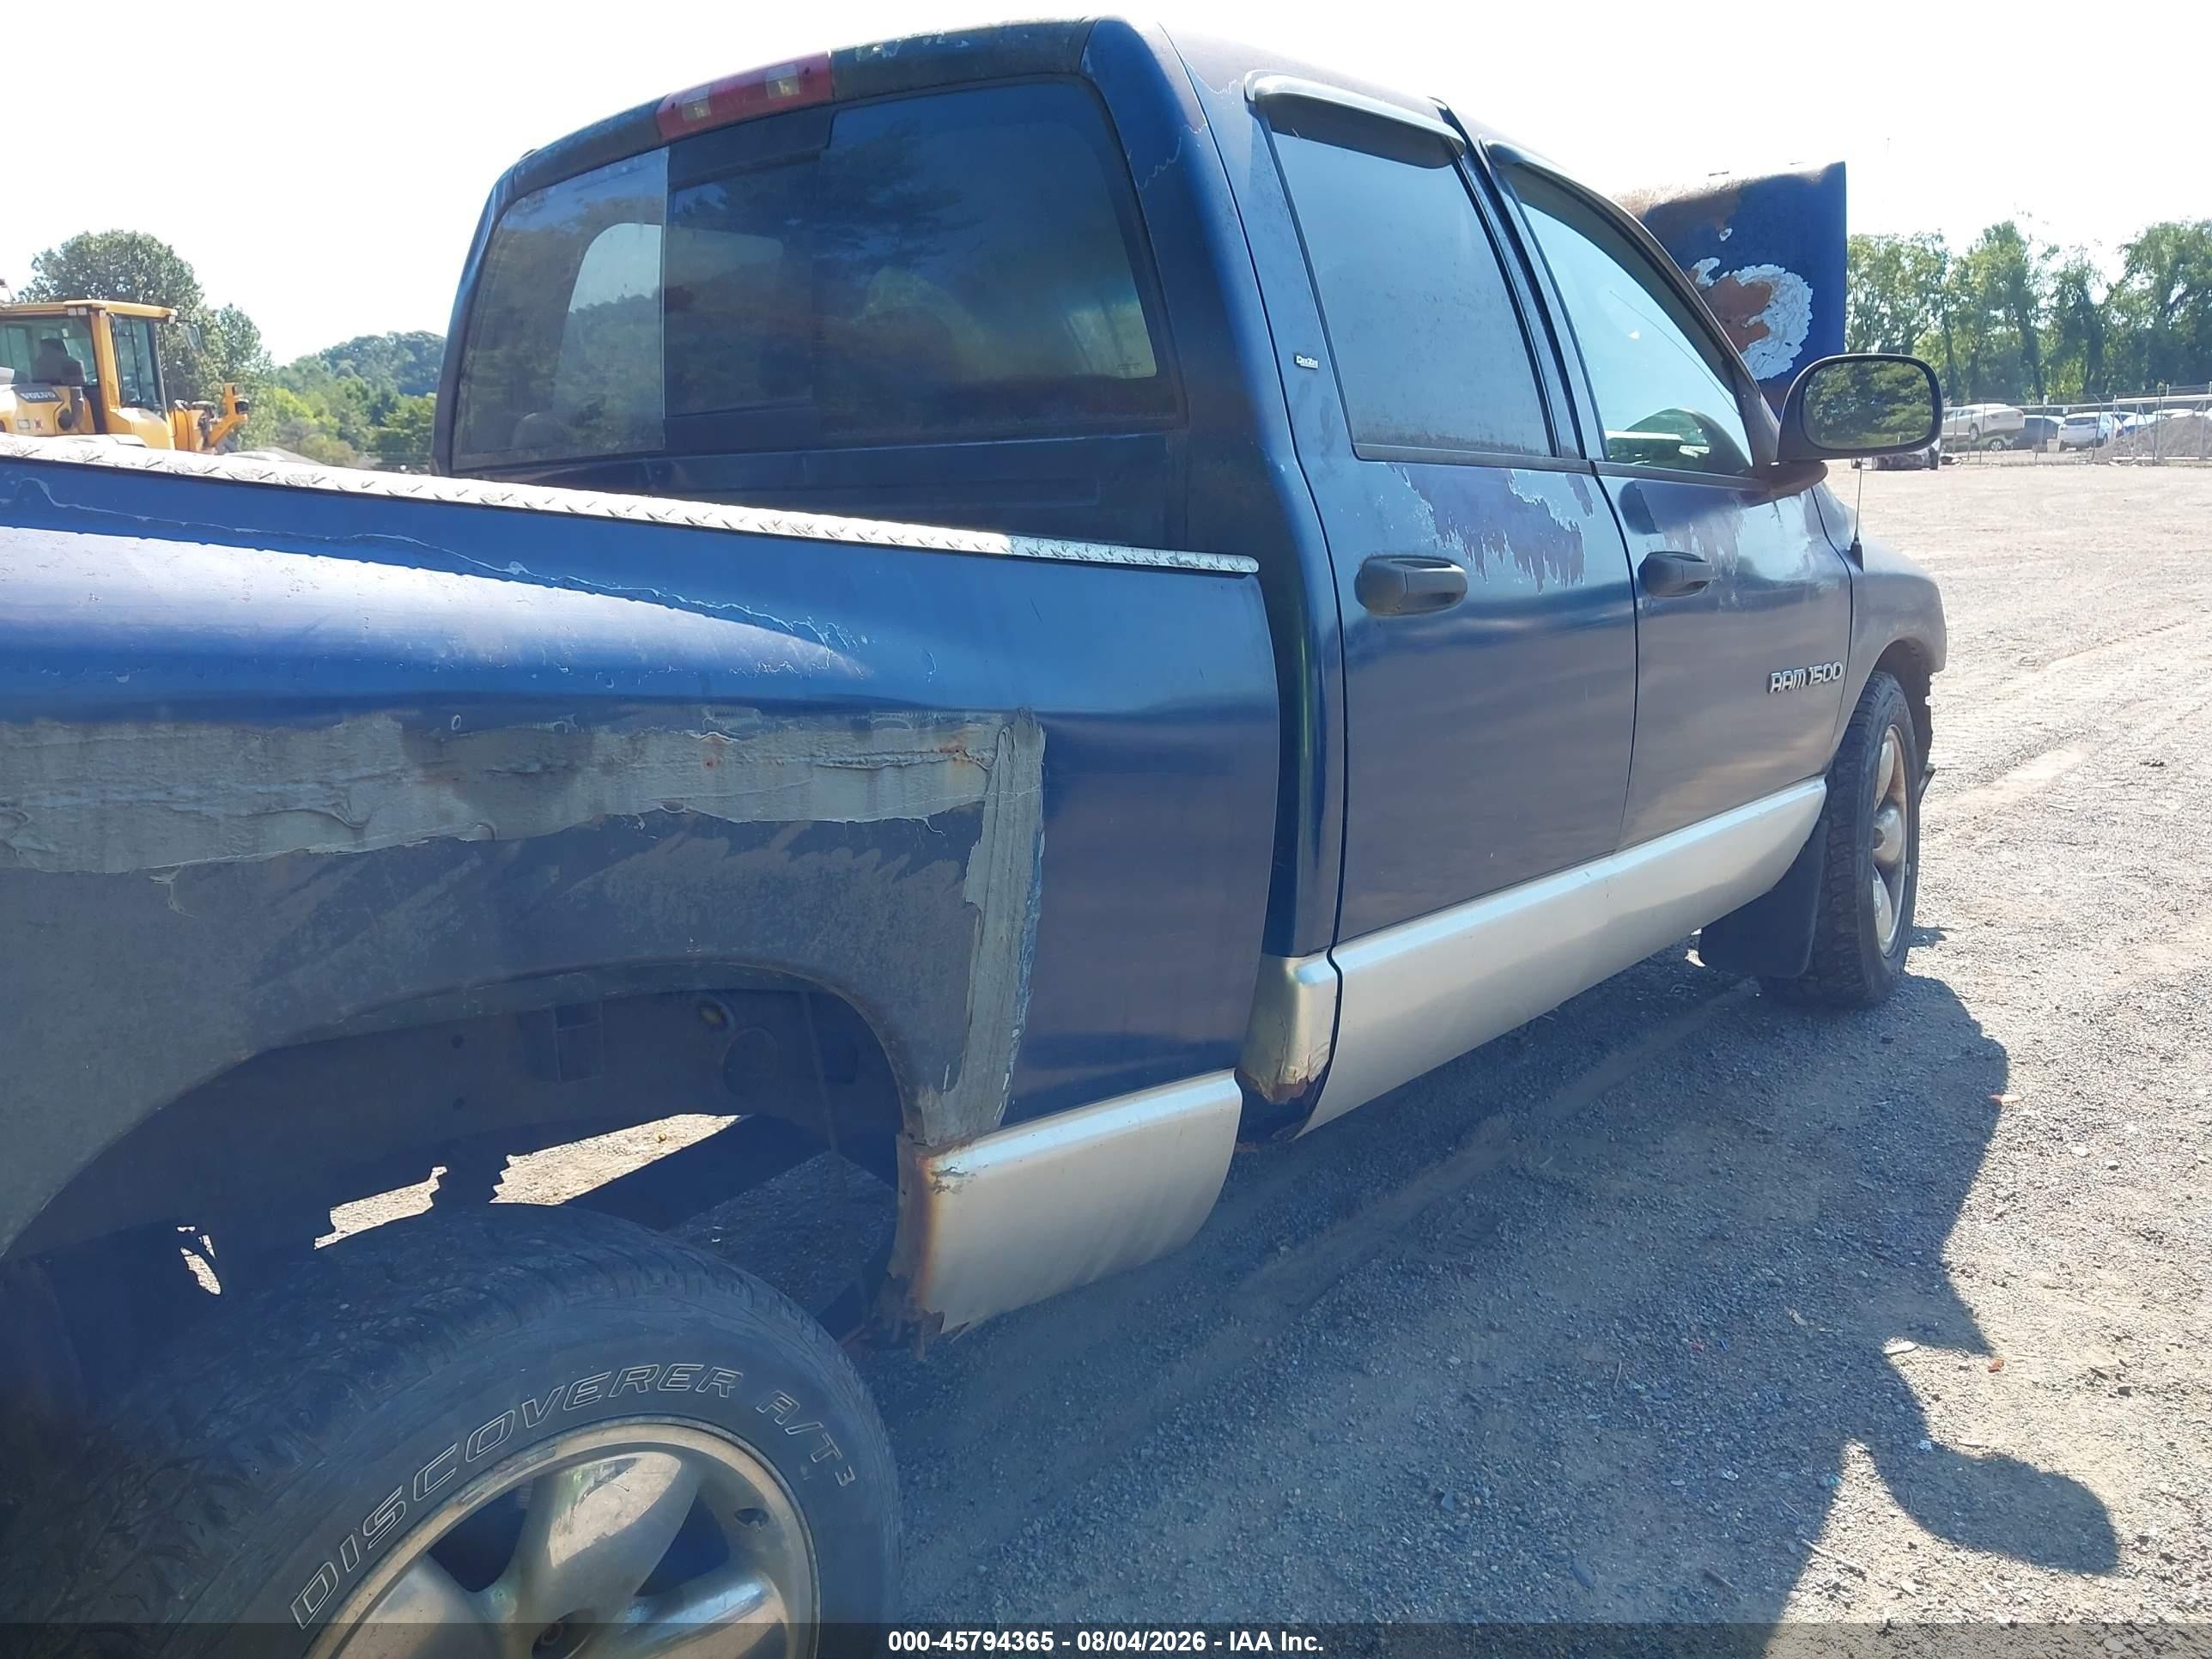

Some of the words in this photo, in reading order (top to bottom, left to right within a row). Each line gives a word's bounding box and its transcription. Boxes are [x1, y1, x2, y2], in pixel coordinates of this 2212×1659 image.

[1770, 669, 1806, 693] RAM
[1808, 661, 1843, 686] 1500
[289, 1363, 744, 1630] DISCOVERER
